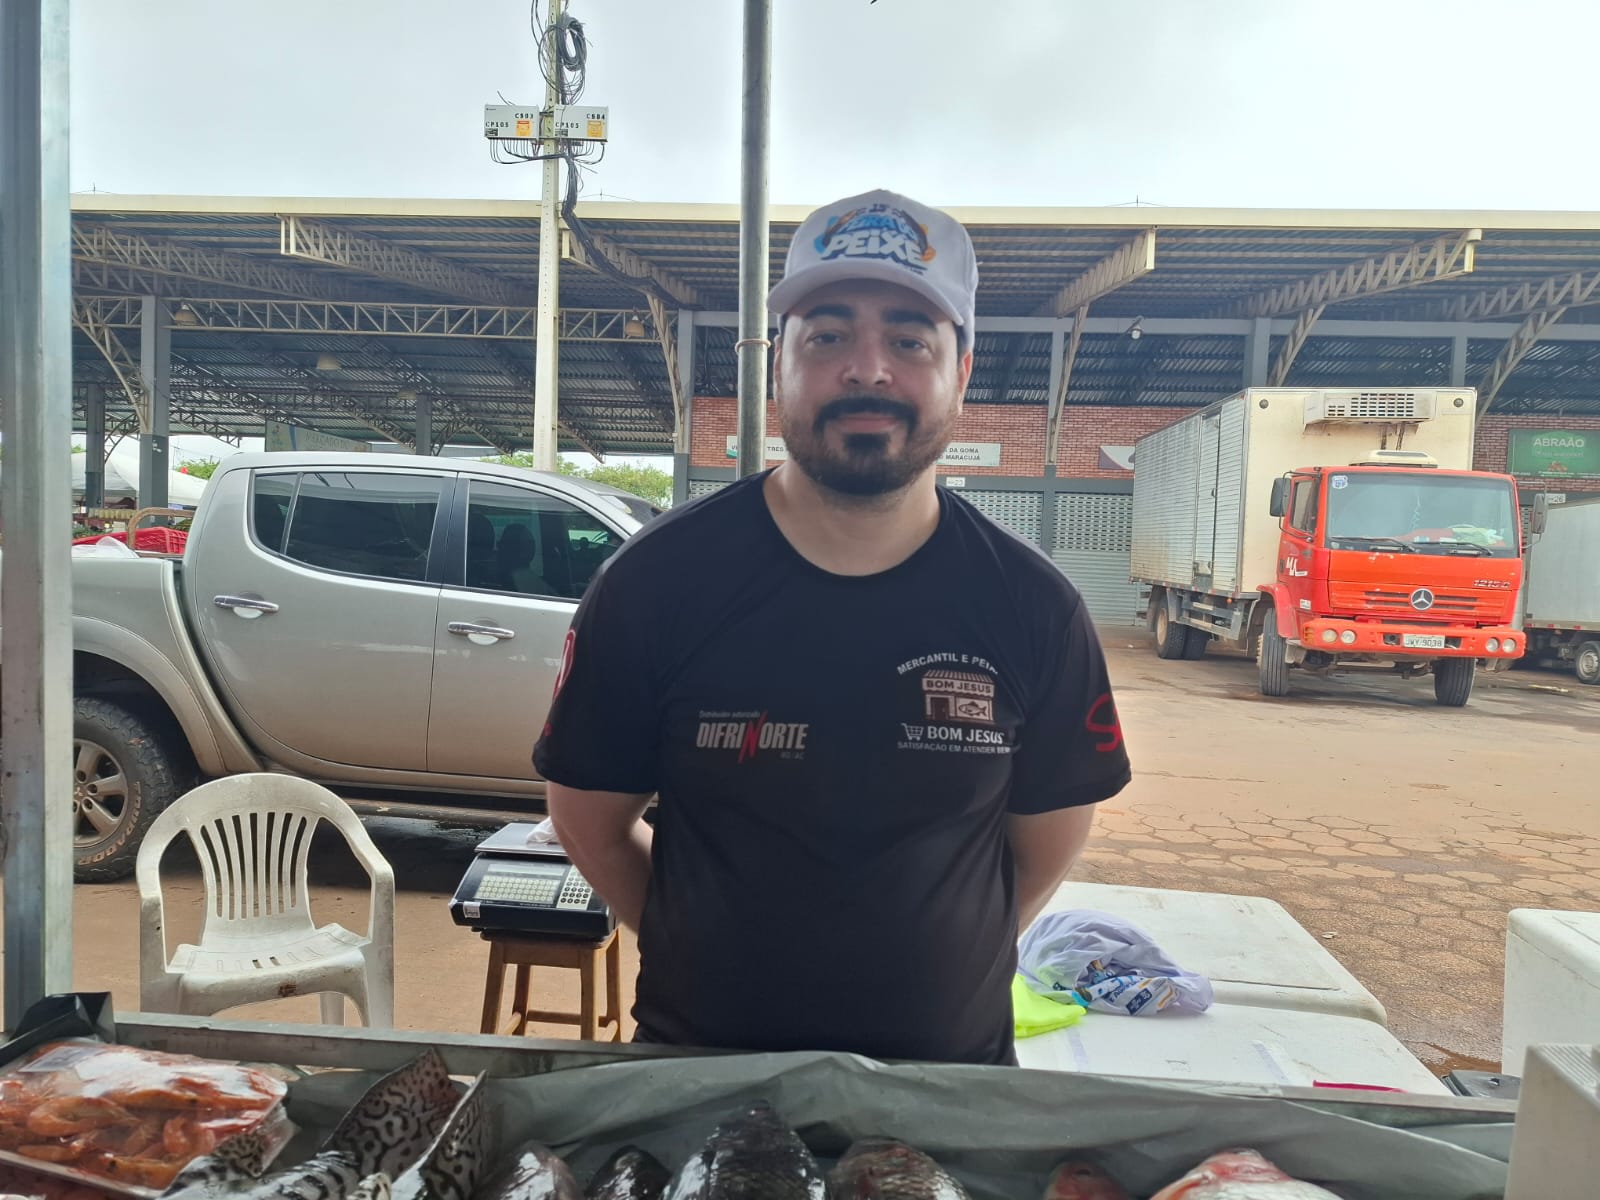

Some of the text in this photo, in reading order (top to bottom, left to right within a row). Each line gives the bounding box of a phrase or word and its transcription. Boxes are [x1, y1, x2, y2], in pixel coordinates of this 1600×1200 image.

[821, 228, 927, 270] PEIXE
[1533, 437, 1585, 448] ABRAÃO
[897, 653, 959, 674] MERCANTIL
[961, 654, 969, 663] E
[926, 680, 991, 693] BOM JESUS
[927, 726, 1005, 744] BOM JESUS
[963, 746, 996, 754] ATENDER
